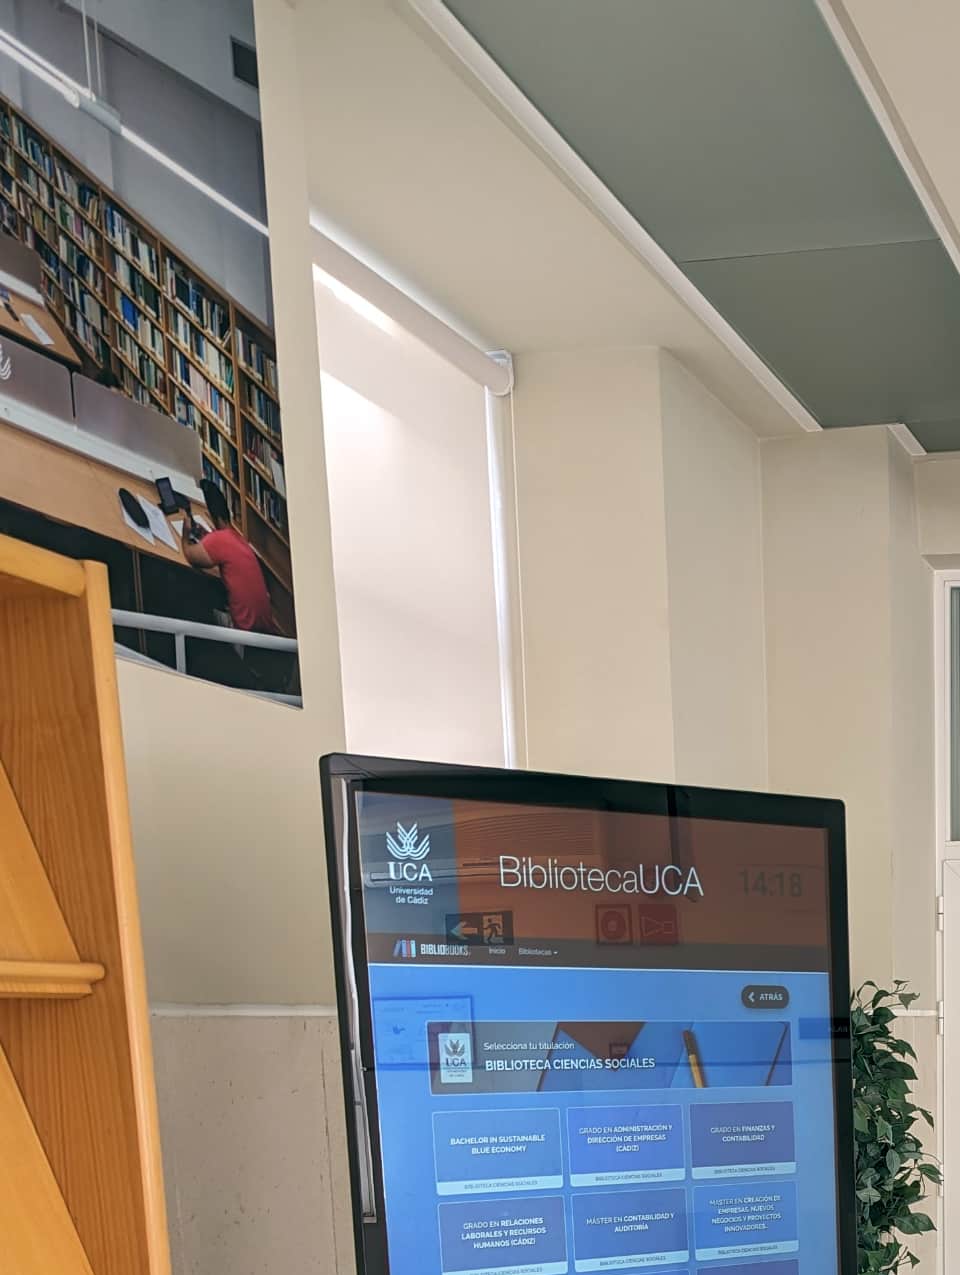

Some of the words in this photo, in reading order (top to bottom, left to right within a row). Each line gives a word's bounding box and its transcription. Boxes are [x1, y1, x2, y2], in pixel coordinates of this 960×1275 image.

[387, 862, 432, 881] UCA
[499, 855, 704, 897] BibliotecaUCA
[390, 886, 433, 896] Universidad
[759, 992, 783, 1002] ATRÁS
[483, 1042, 527, 1050] Selecciona
[529, 1042, 537, 1050] tu
[539, 1042, 575, 1050] titulación
[485, 1060, 551, 1071] BIBLIOTECA
[553, 1059, 602, 1069] CIENCIAS
[605, 1058, 655, 1068] SOCIALES
[450, 1137, 488, 1145] BACHELOR
[499, 1134, 545, 1143] SUSTAINABLE
[491, 1145, 526, 1153] ECONOMY
[501, 1218, 544, 1226] RELACIONES
[461, 1231, 502, 1240] LABORALES
[510, 1227, 546, 1236] RECURSOS
[473, 1240, 510, 1249] HUMANOS
